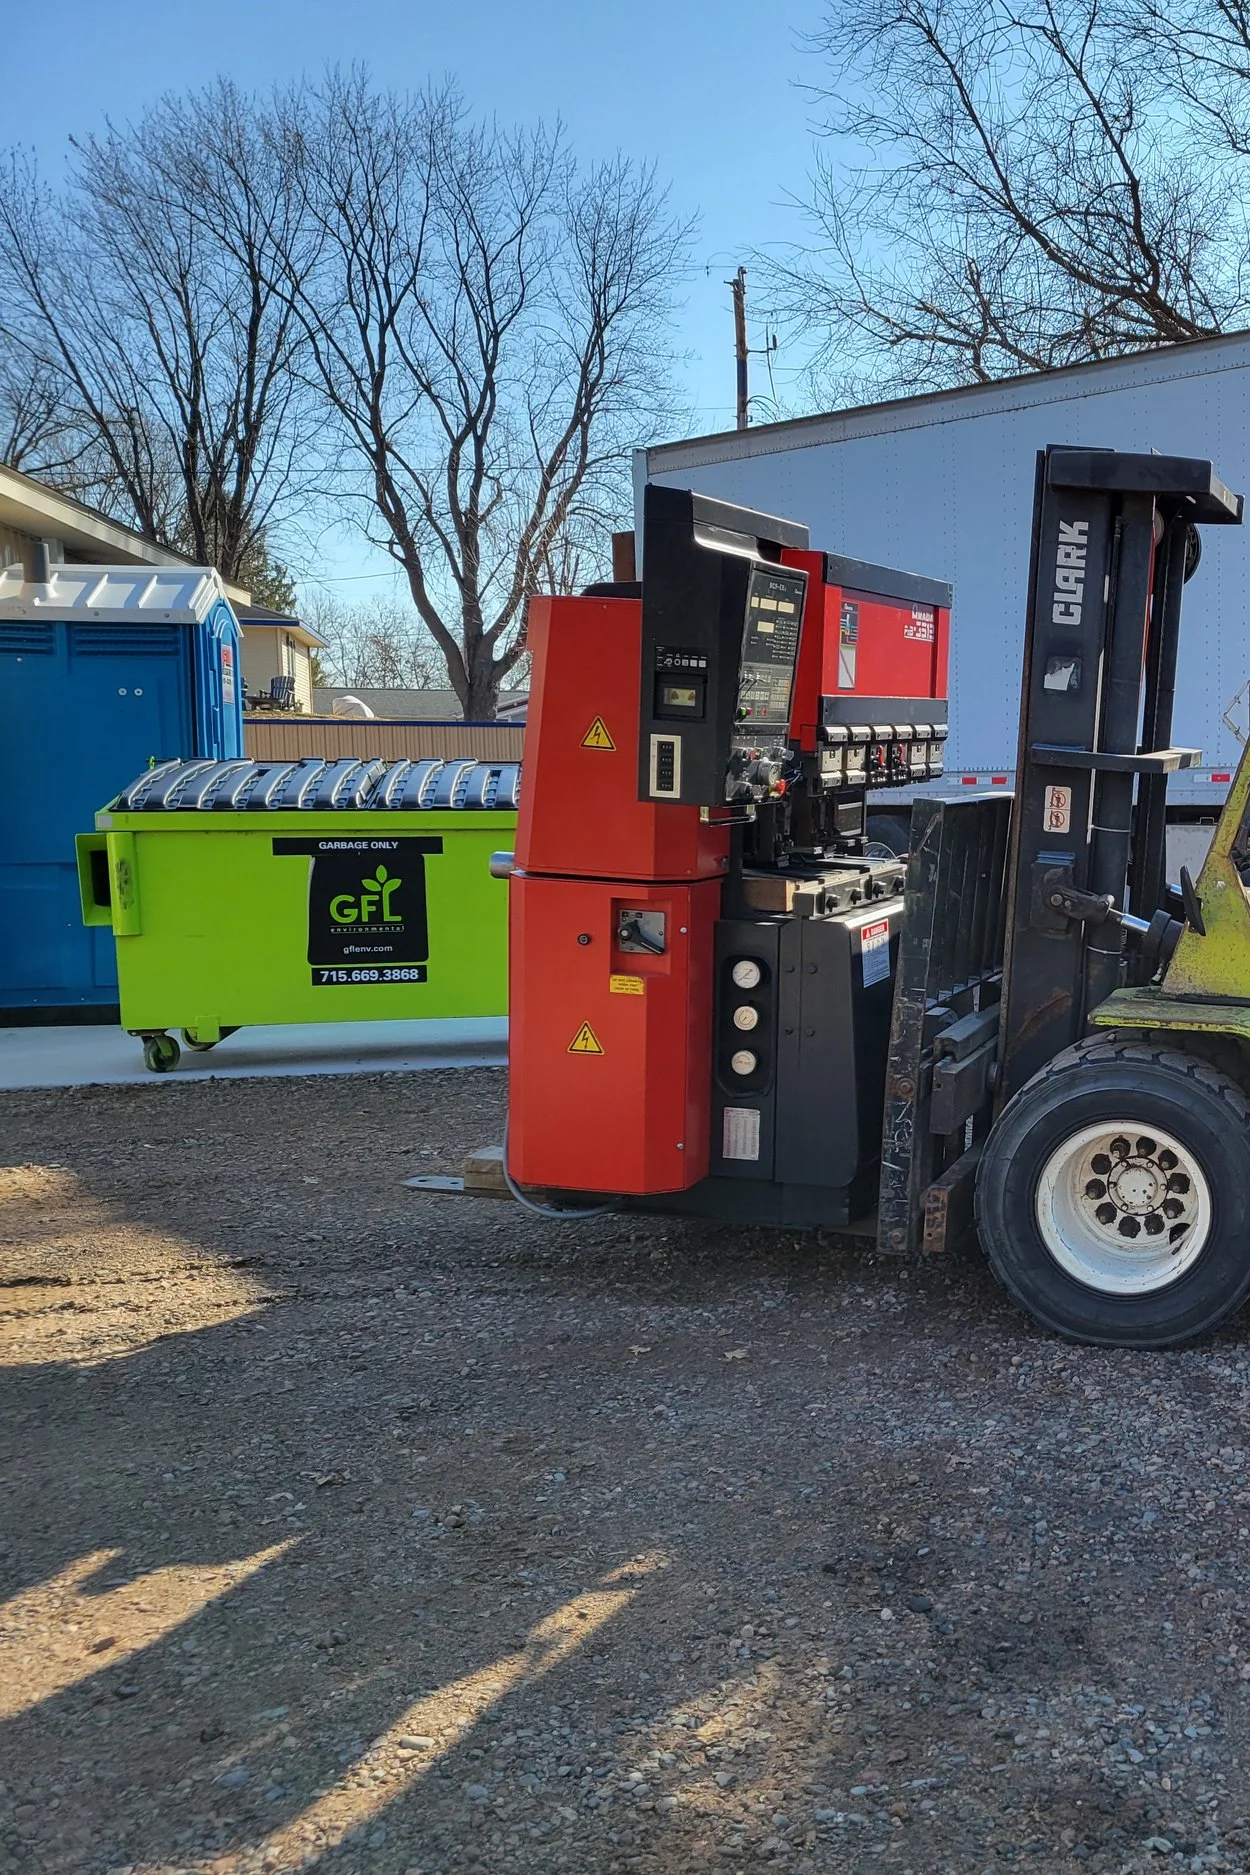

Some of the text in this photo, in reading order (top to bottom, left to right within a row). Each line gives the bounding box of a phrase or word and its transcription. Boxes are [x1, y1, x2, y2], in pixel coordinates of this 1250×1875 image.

[1052, 520, 1089, 625] CLARK
[318, 841, 399, 850] GARBAGE ONLY
[330, 878, 402, 923] GFL
[343, 945, 393, 955] gflenv.com
[320, 968, 419, 983] 715.669.3868
